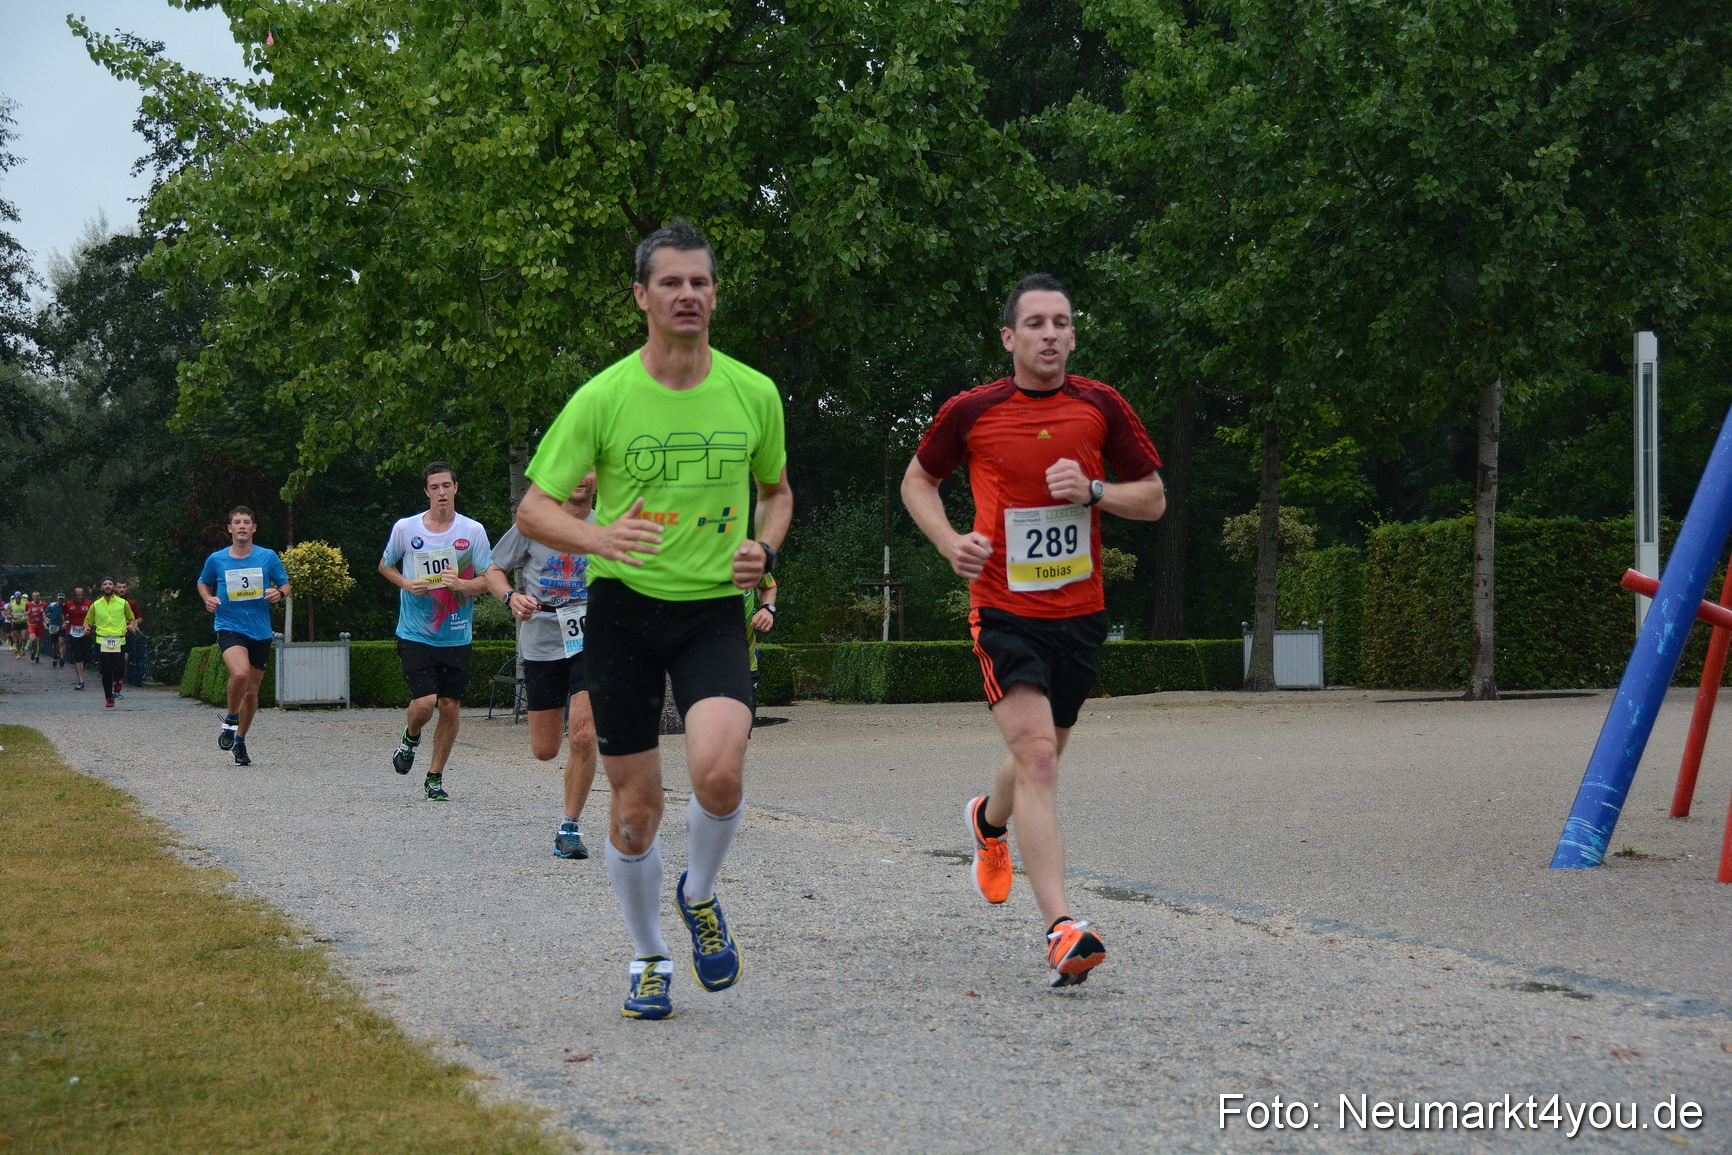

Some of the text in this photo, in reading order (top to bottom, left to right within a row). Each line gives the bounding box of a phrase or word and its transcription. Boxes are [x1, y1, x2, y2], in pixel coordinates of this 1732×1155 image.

[636, 511, 679, 525] ERZ
[1026, 524, 1078, 559] 289
[423, 558, 450, 575] 100
[1035, 565, 1072, 579] Tobias
[241, 576, 249, 589] 3
[425, 577, 442, 585] hrist
[236, 590, 257, 598] Michael
